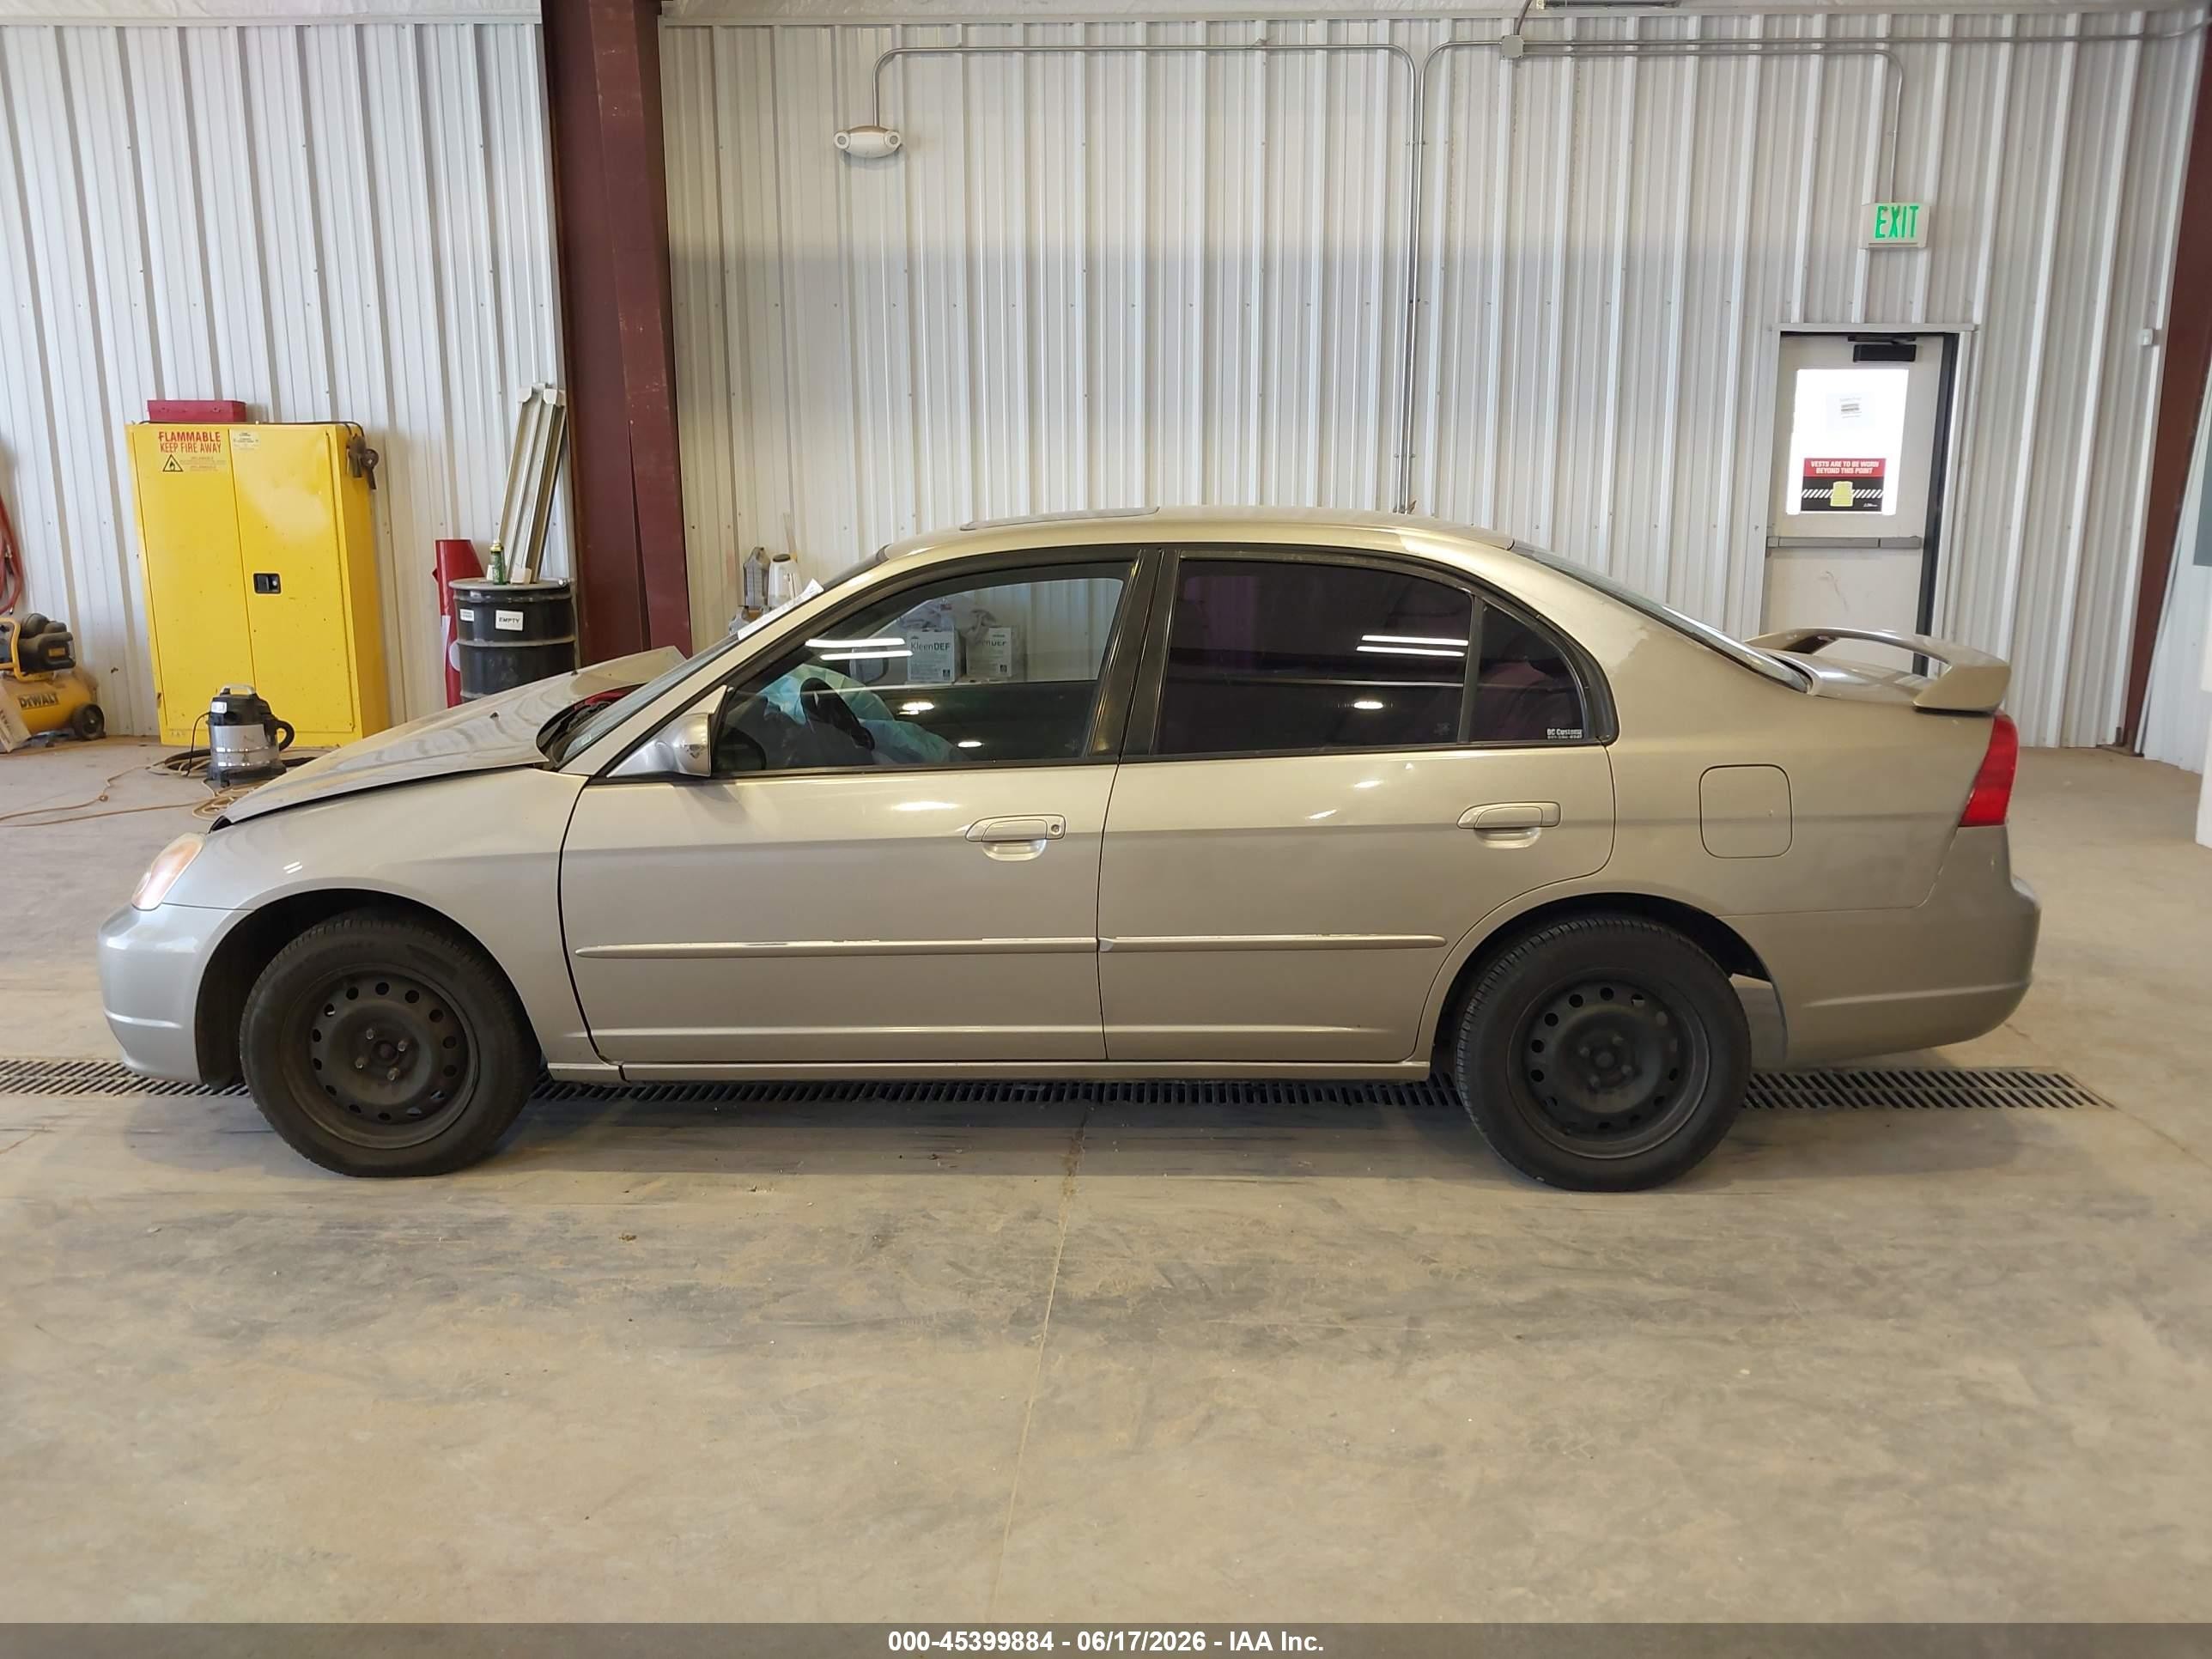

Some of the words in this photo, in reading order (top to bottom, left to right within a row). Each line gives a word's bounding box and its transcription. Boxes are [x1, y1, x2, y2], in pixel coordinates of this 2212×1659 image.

[1875, 205, 1919, 239] EXIT
[158, 431, 221, 442] FLAMMABLE
[160, 442, 179, 453] KEEP
[180, 442, 198, 453] FIRE
[200, 442, 222, 453] AWAY
[910, 641, 951, 651] KleenDEF
